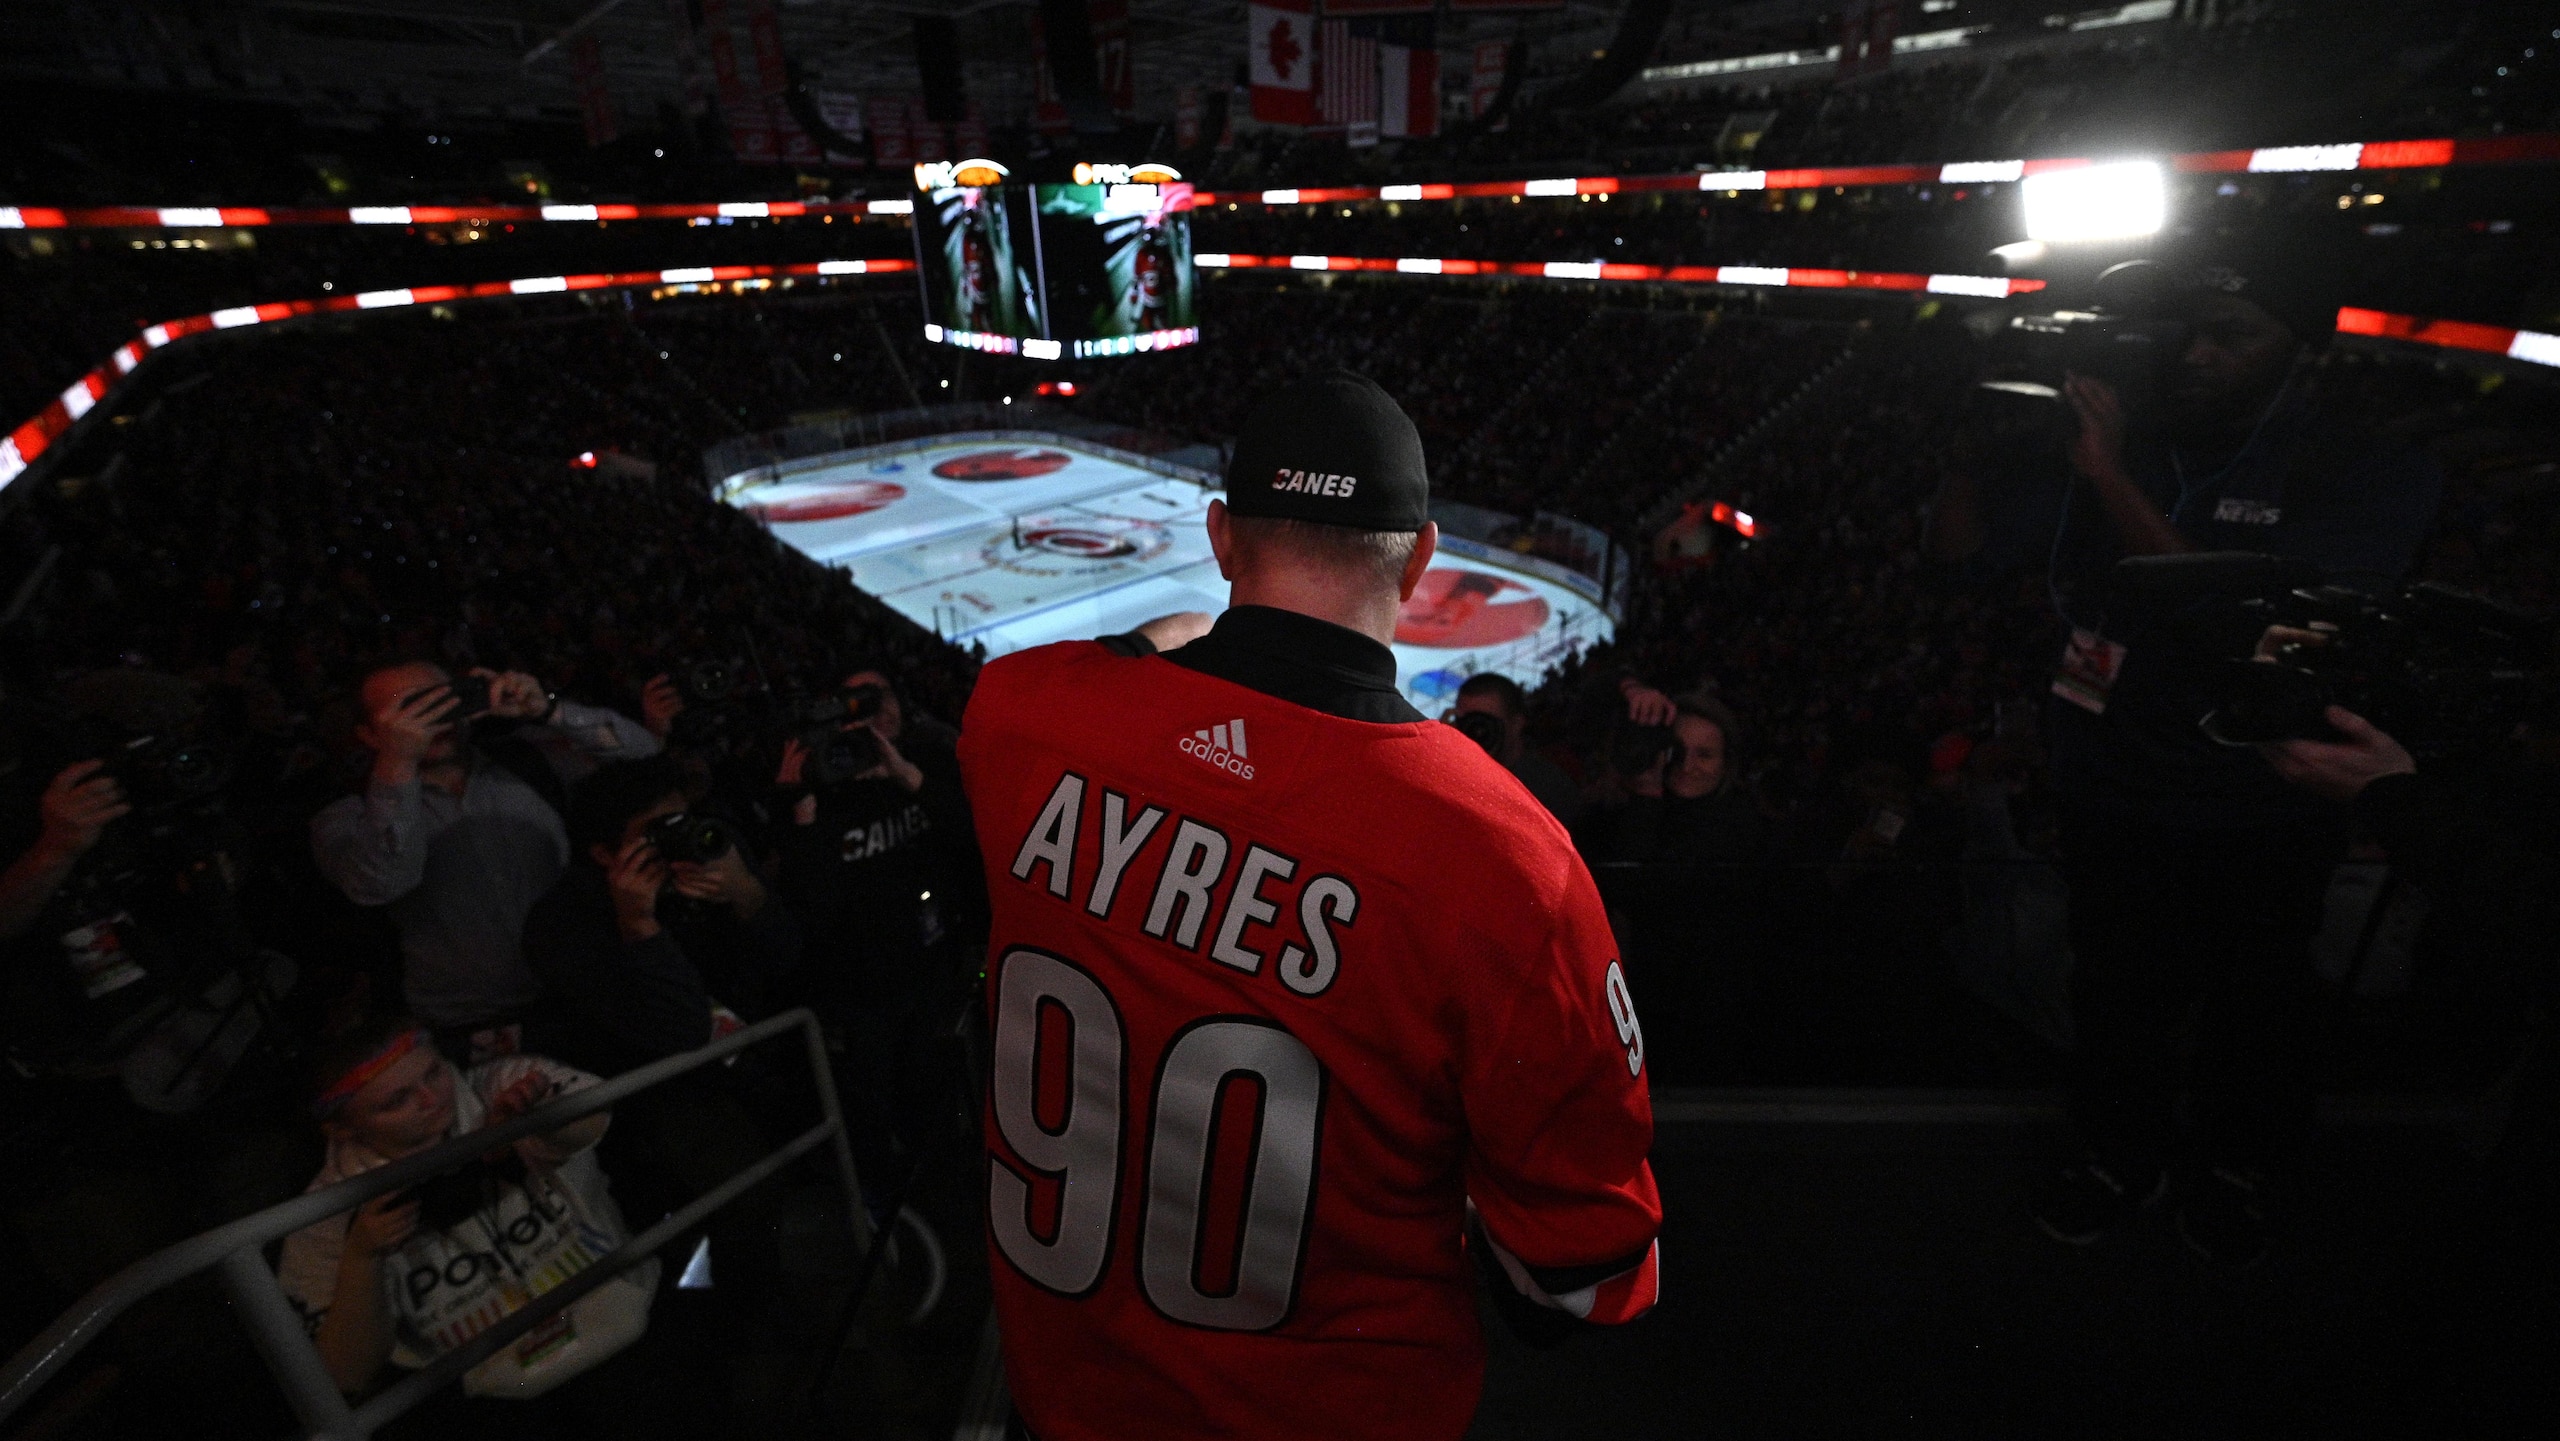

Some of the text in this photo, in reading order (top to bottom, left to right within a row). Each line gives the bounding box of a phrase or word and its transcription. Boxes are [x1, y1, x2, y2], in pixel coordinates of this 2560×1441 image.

[1272, 468, 1357, 499] CANES
[1179, 737, 1255, 780] adidas
[1010, 770, 1360, 998] AYRES
[989, 945, 1328, 1332] 90
